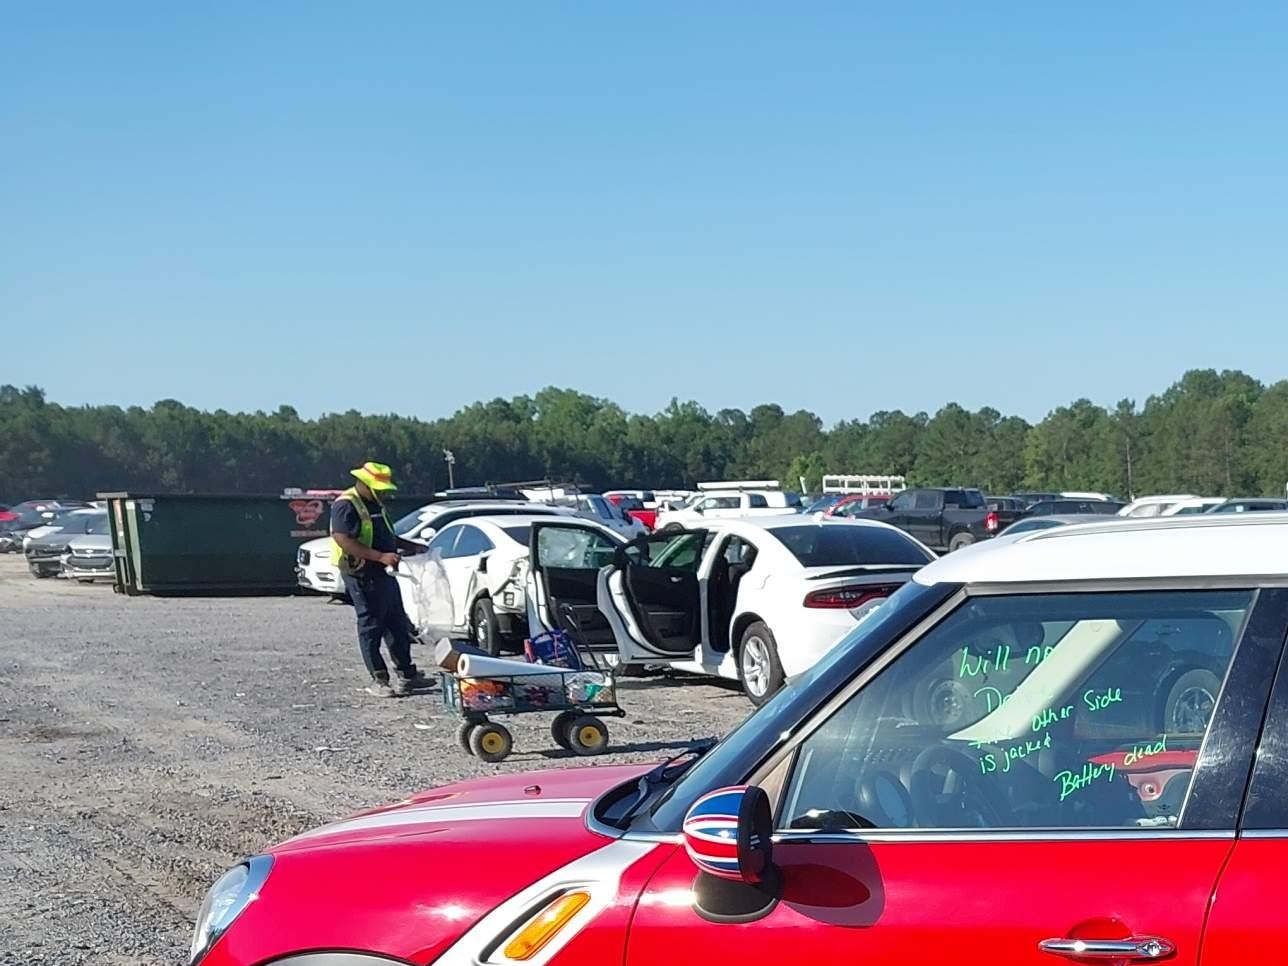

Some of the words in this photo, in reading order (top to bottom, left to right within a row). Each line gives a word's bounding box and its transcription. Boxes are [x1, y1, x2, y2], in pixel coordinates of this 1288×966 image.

[960, 645, 1010, 678] Will
[1032, 705, 1074, 731] other
[980, 754, 996, 774] is
[1053, 763, 1115, 801] Battery
[1124, 734, 1167, 766] dead
